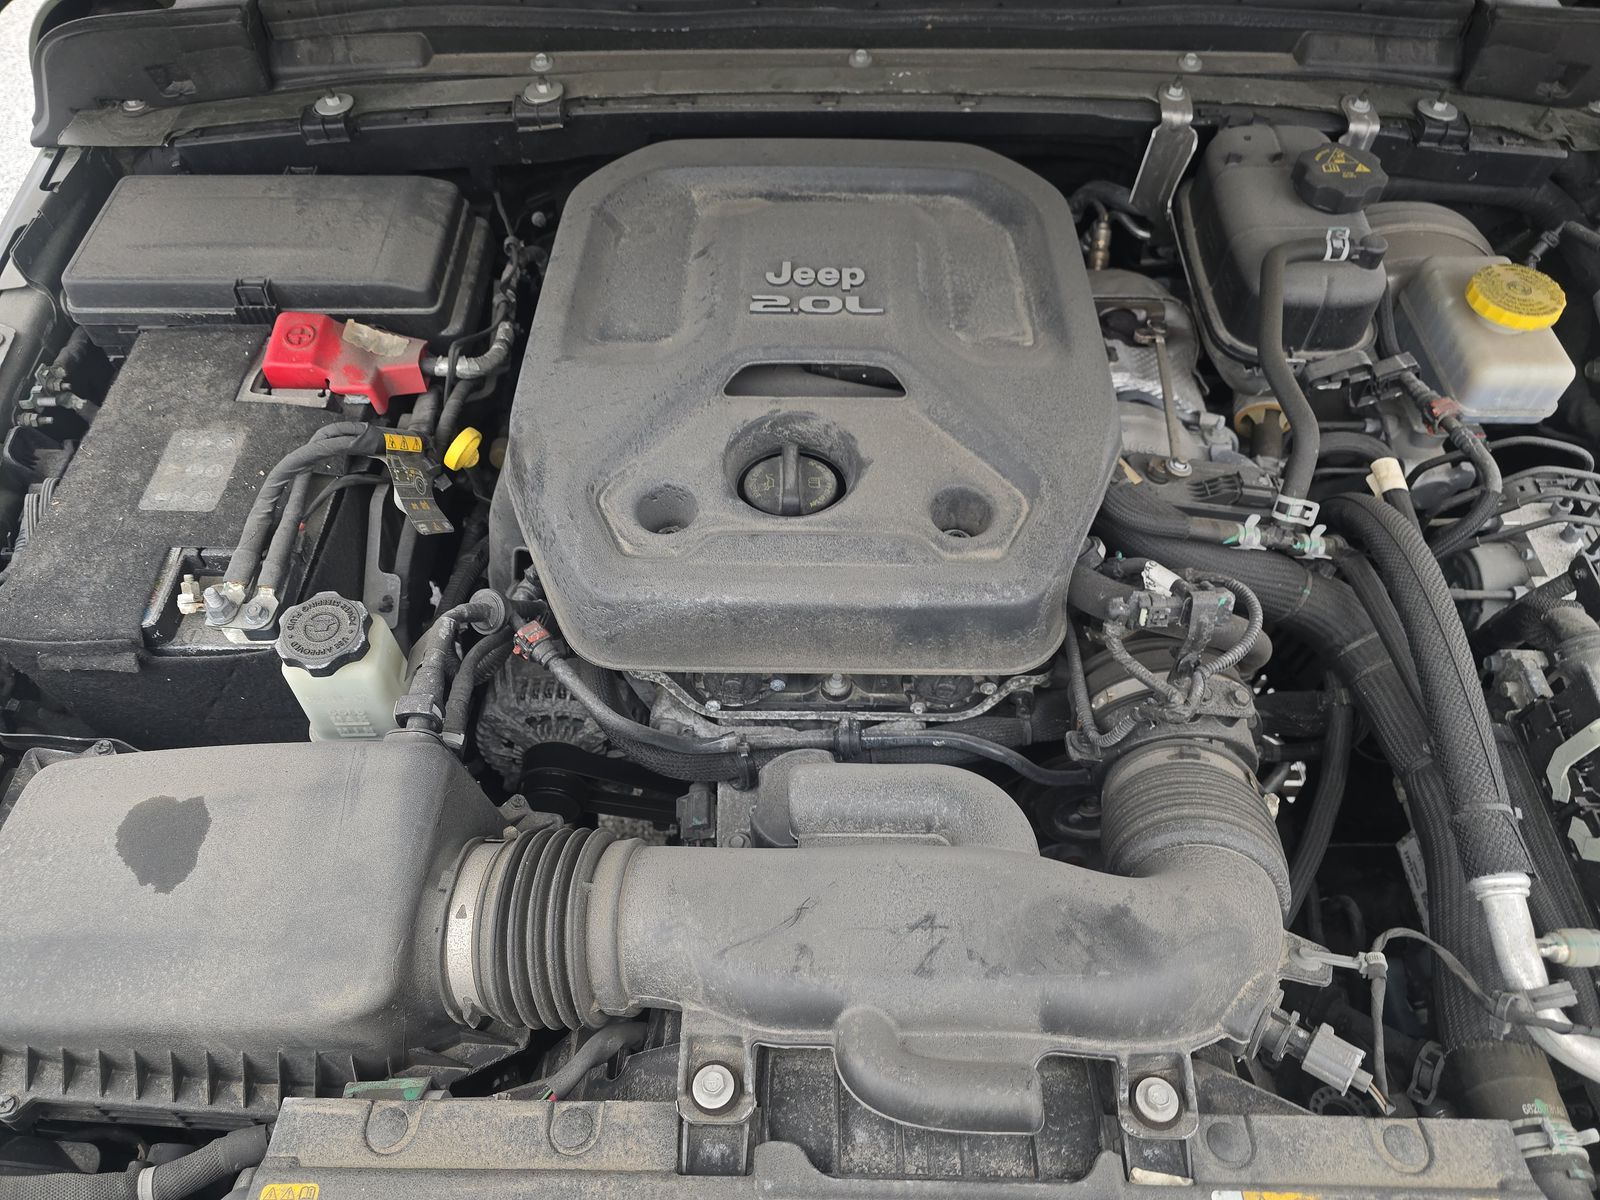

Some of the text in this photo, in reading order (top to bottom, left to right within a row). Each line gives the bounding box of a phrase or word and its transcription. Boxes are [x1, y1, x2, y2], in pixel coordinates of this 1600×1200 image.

[765, 261, 866, 292] Jeep
[750, 295, 884, 314] 2.0L
[286, 599, 357, 631] POWER STEERING FLUID
[290, 636, 349, 656] USE APPROVED
